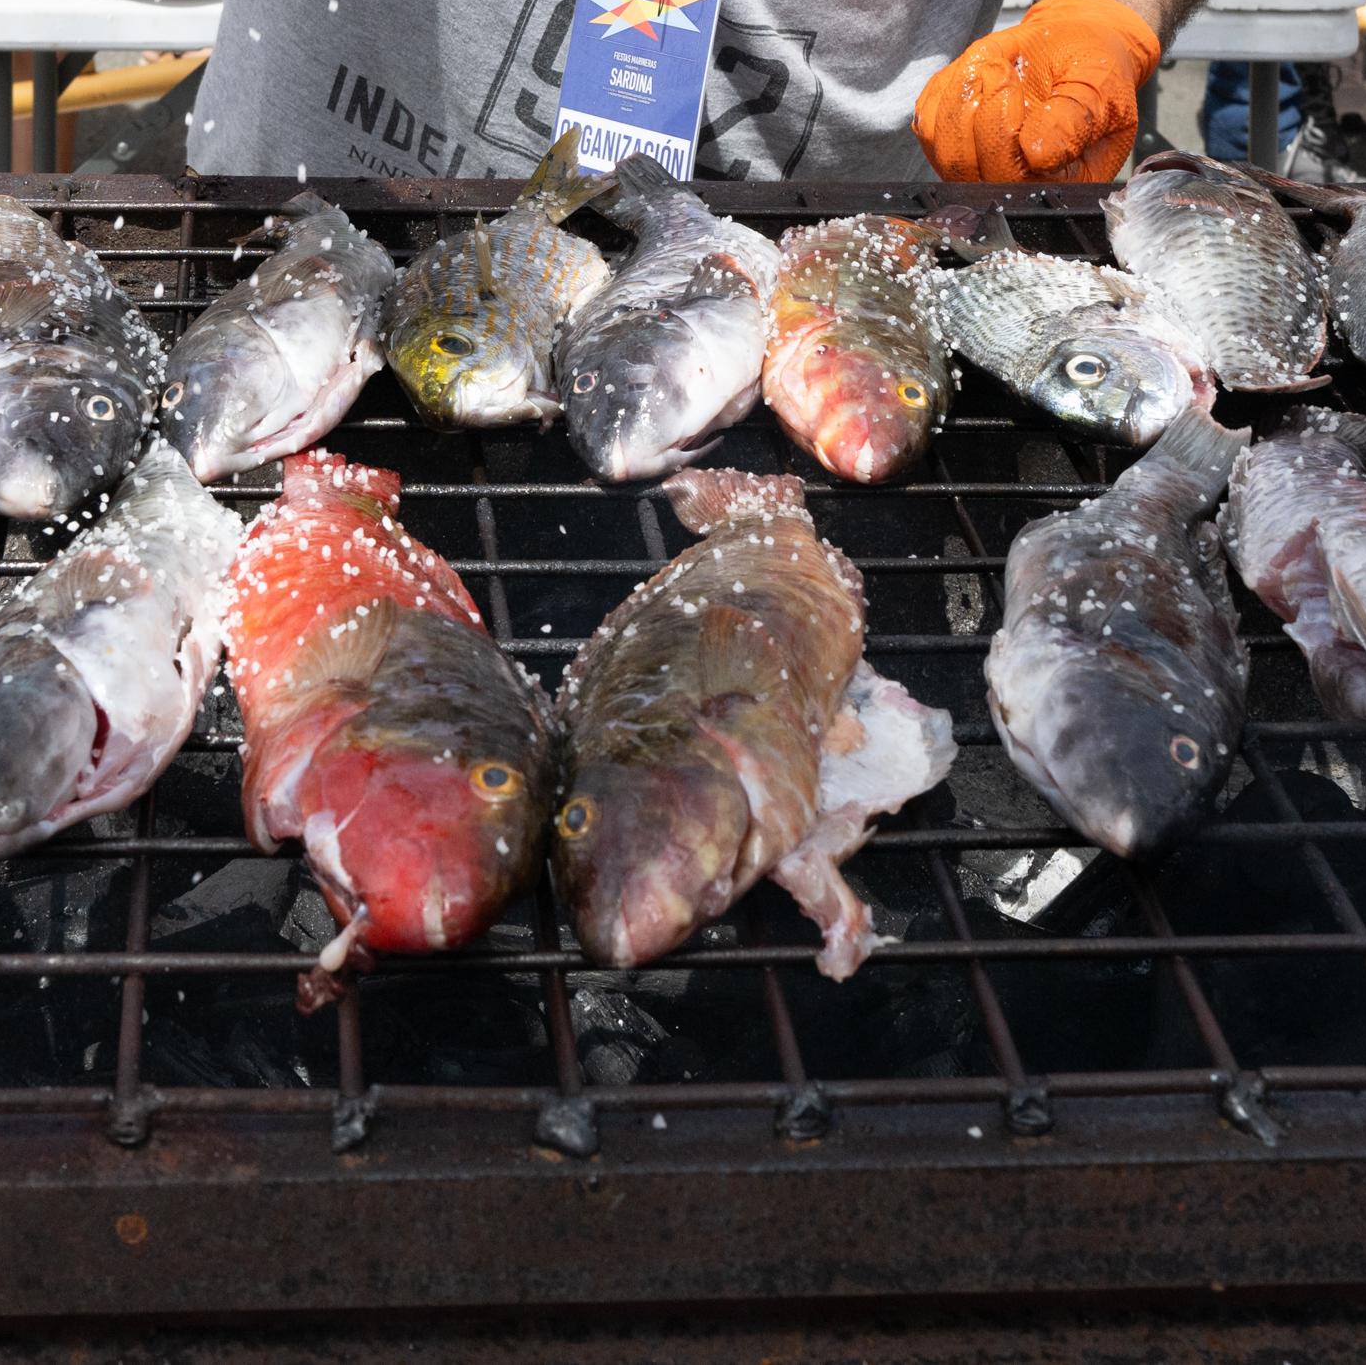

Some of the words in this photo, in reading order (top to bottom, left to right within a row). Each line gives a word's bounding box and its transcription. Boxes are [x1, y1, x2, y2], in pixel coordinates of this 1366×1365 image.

[613, 51, 631, 64] FIESTAS
[631, 55, 658, 69] MARINERAS
[609, 67, 653, 94] SARDINA
[560, 119, 685, 181] GANIZIÓN
